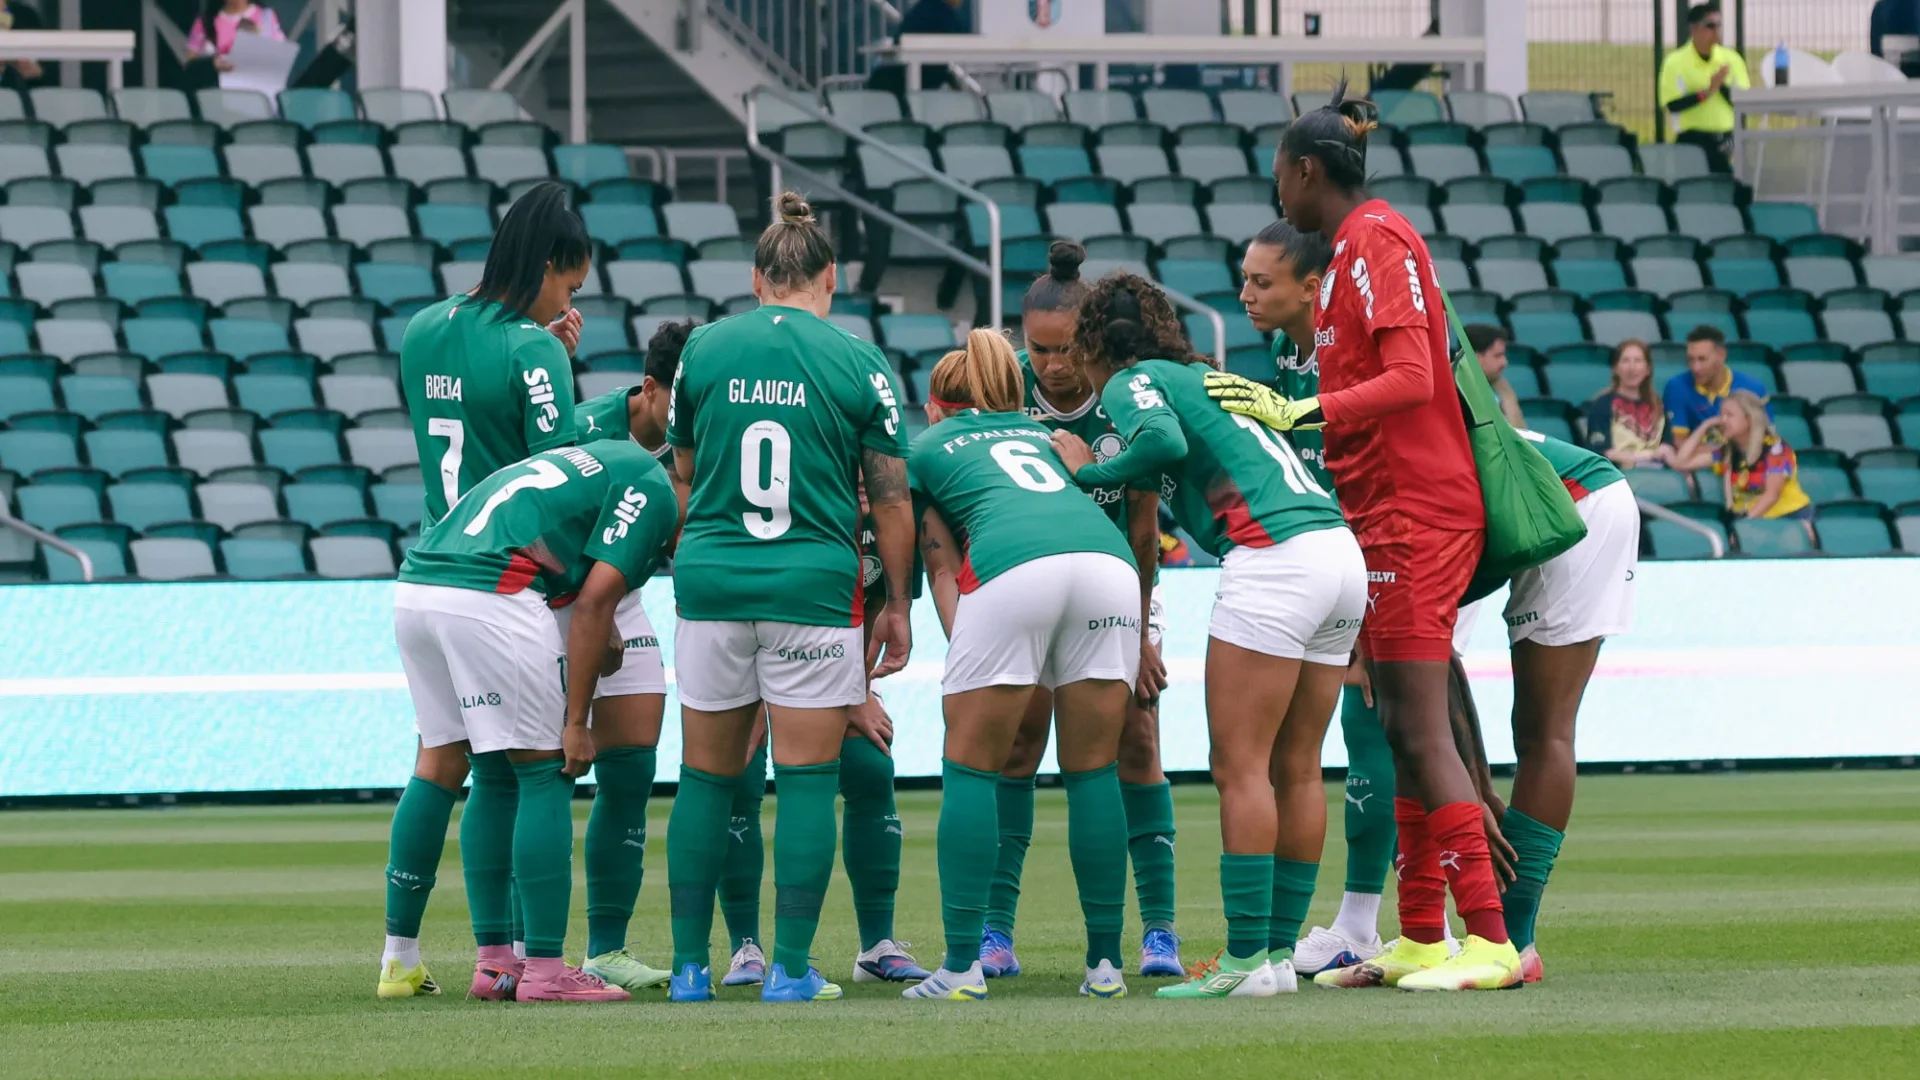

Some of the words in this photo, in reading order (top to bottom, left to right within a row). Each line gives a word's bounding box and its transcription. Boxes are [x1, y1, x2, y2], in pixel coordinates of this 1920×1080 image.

[729, 378, 806, 408] GLAUCIA
[428, 417, 464, 510] 7
[943, 436, 970, 455] FE
[989, 440, 1066, 493] 6
[740, 420, 792, 540] 9
